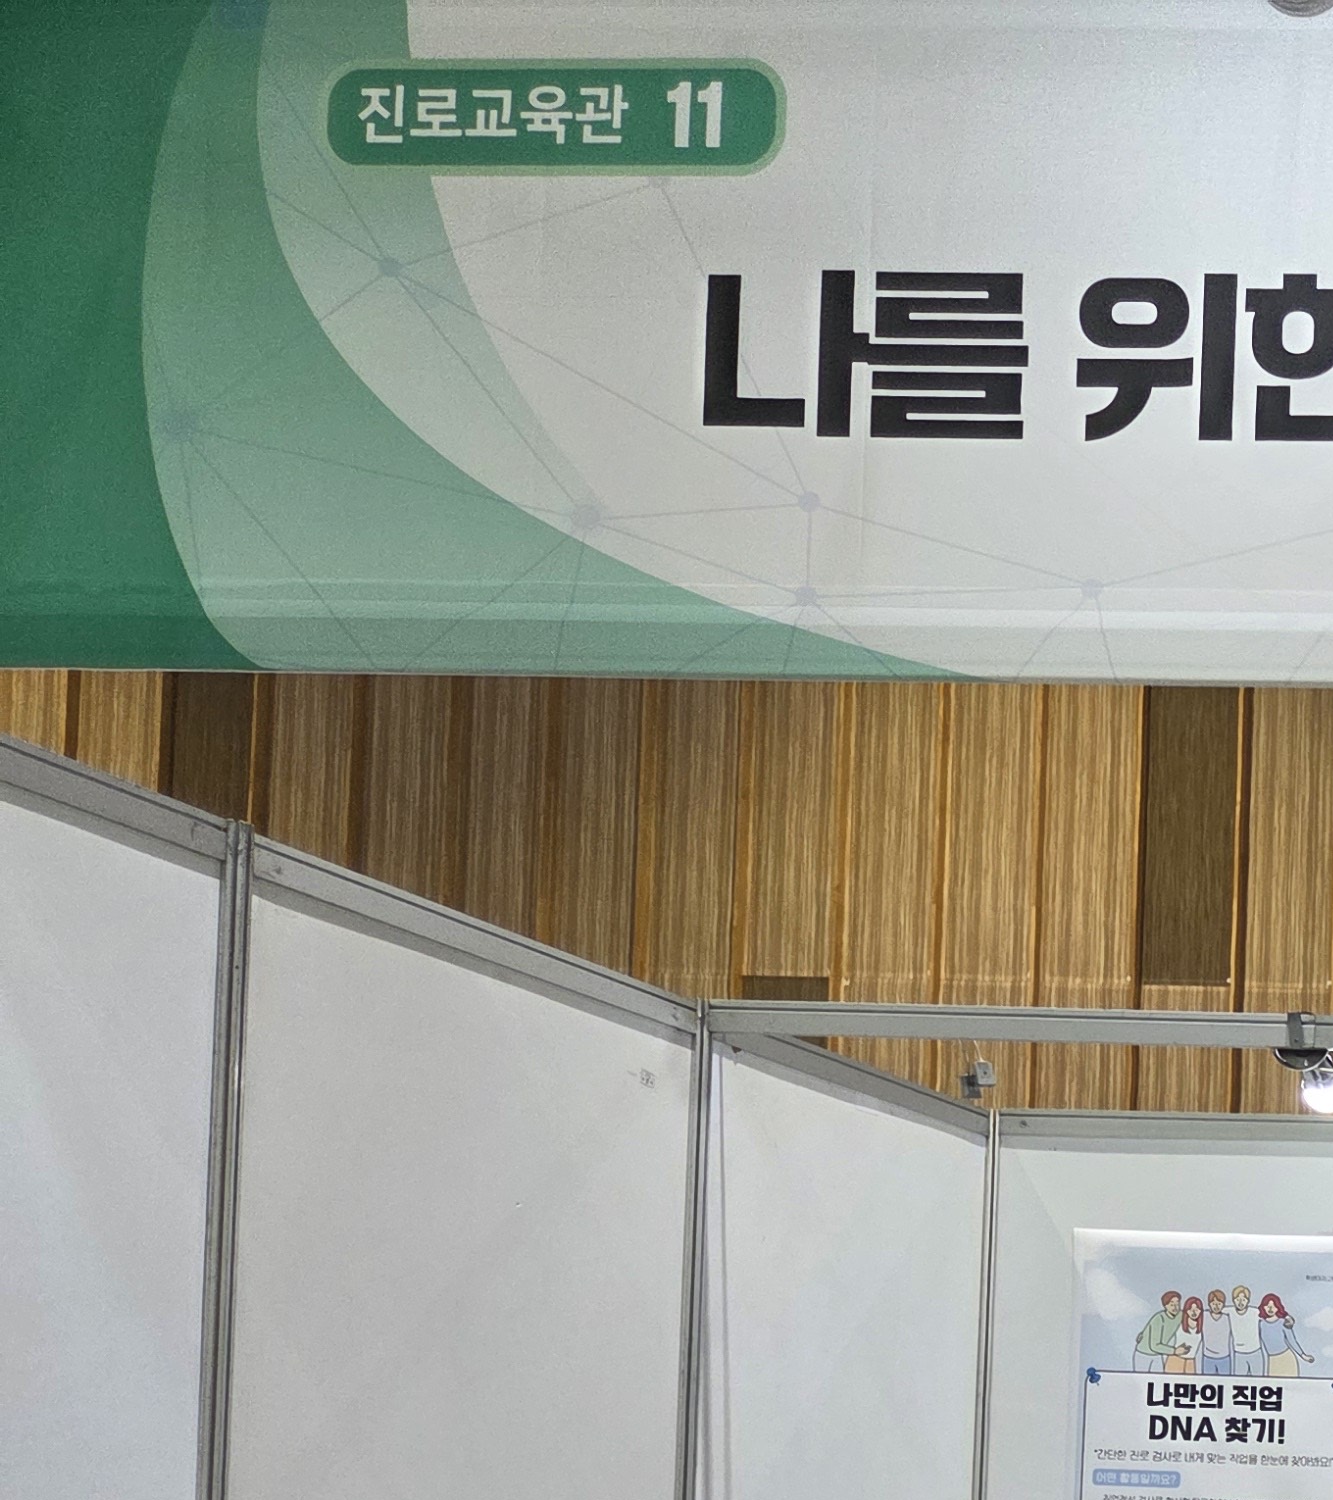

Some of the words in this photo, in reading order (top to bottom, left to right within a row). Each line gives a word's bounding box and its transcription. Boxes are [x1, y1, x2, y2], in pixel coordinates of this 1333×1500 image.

[357, 85, 630, 146] 진로교육관
[666, 81, 725, 150] 11
[702, 269, 1029, 440] 나를
[1146, 1382, 1224, 1410] 나만의
[1232, 1385, 1283, 1412] 직업
[1148, 1415, 1217, 1442] DNA
[1225, 1417, 1286, 1445] 찾기!
